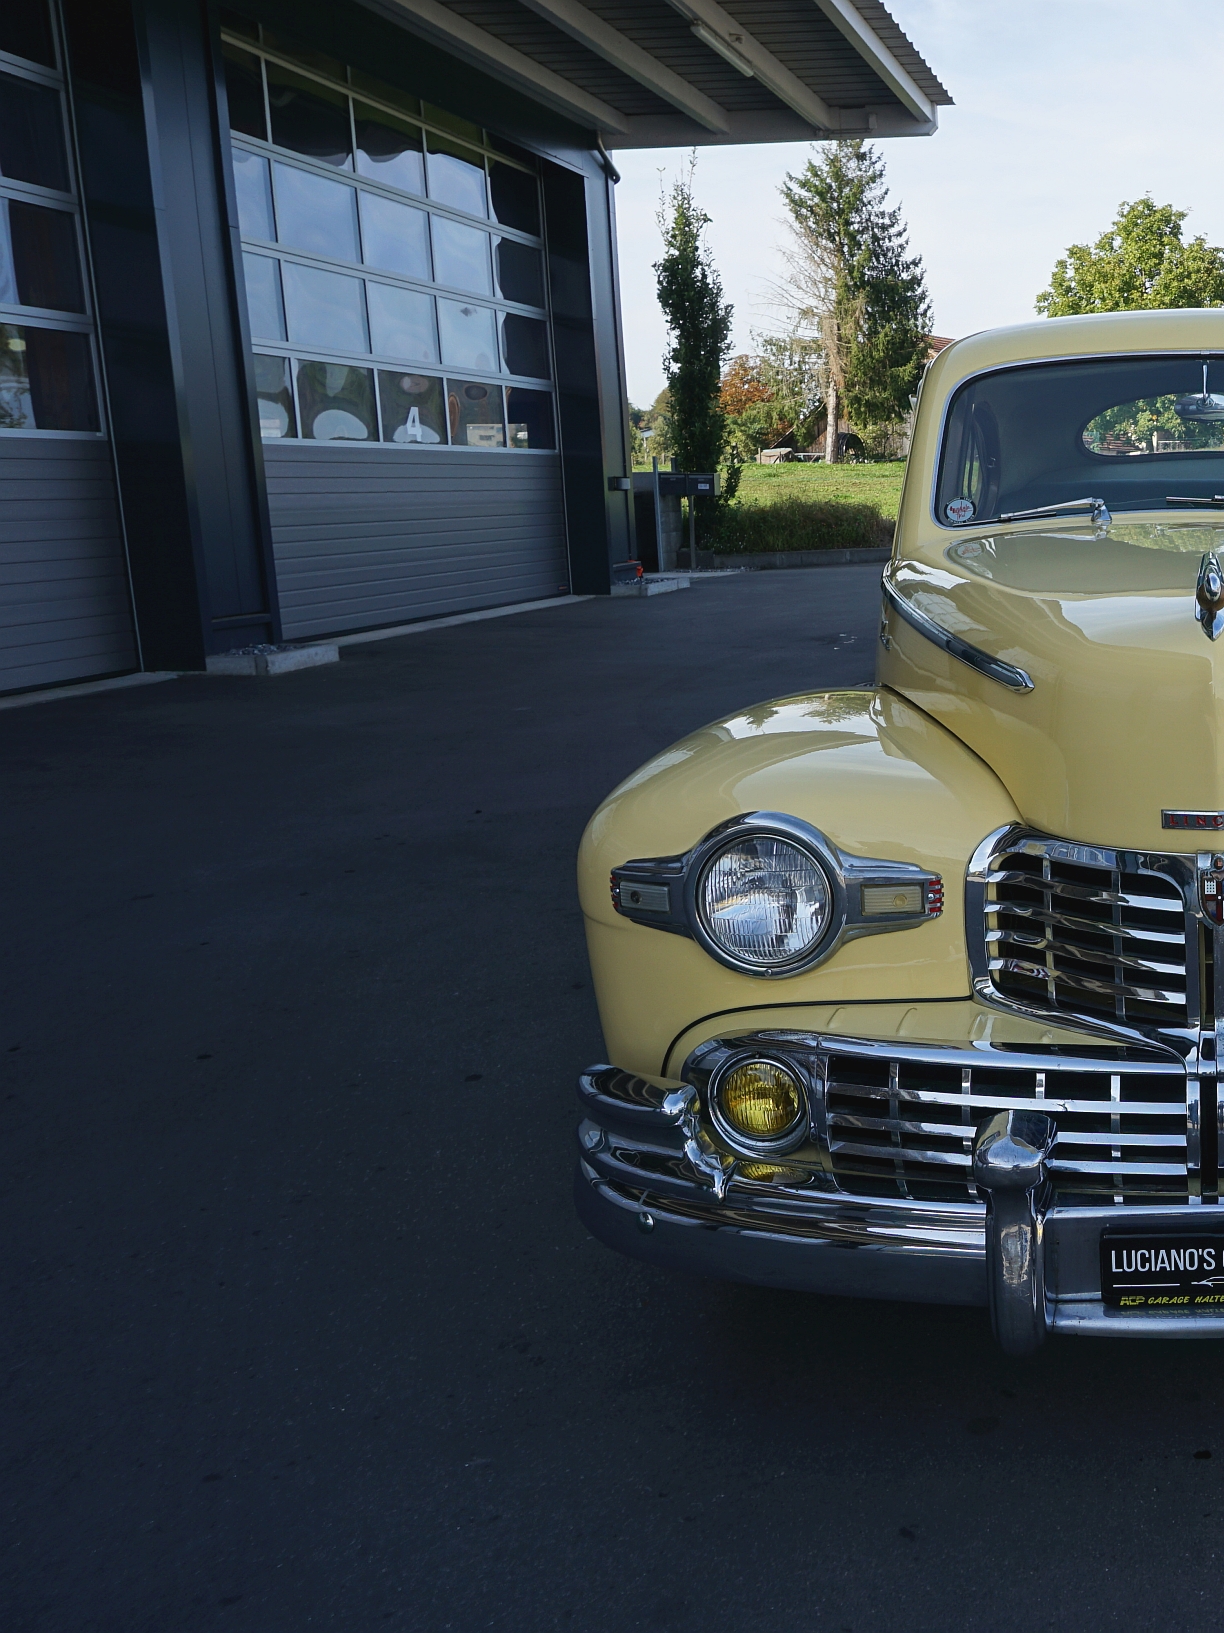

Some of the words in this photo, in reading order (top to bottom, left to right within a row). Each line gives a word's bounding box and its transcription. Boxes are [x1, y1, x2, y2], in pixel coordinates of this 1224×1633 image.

[406, 406, 422, 442] 4
[1111, 1248, 1216, 1273] LUCIANO'S
[1147, 1296, 1190, 1305] GARAGE
